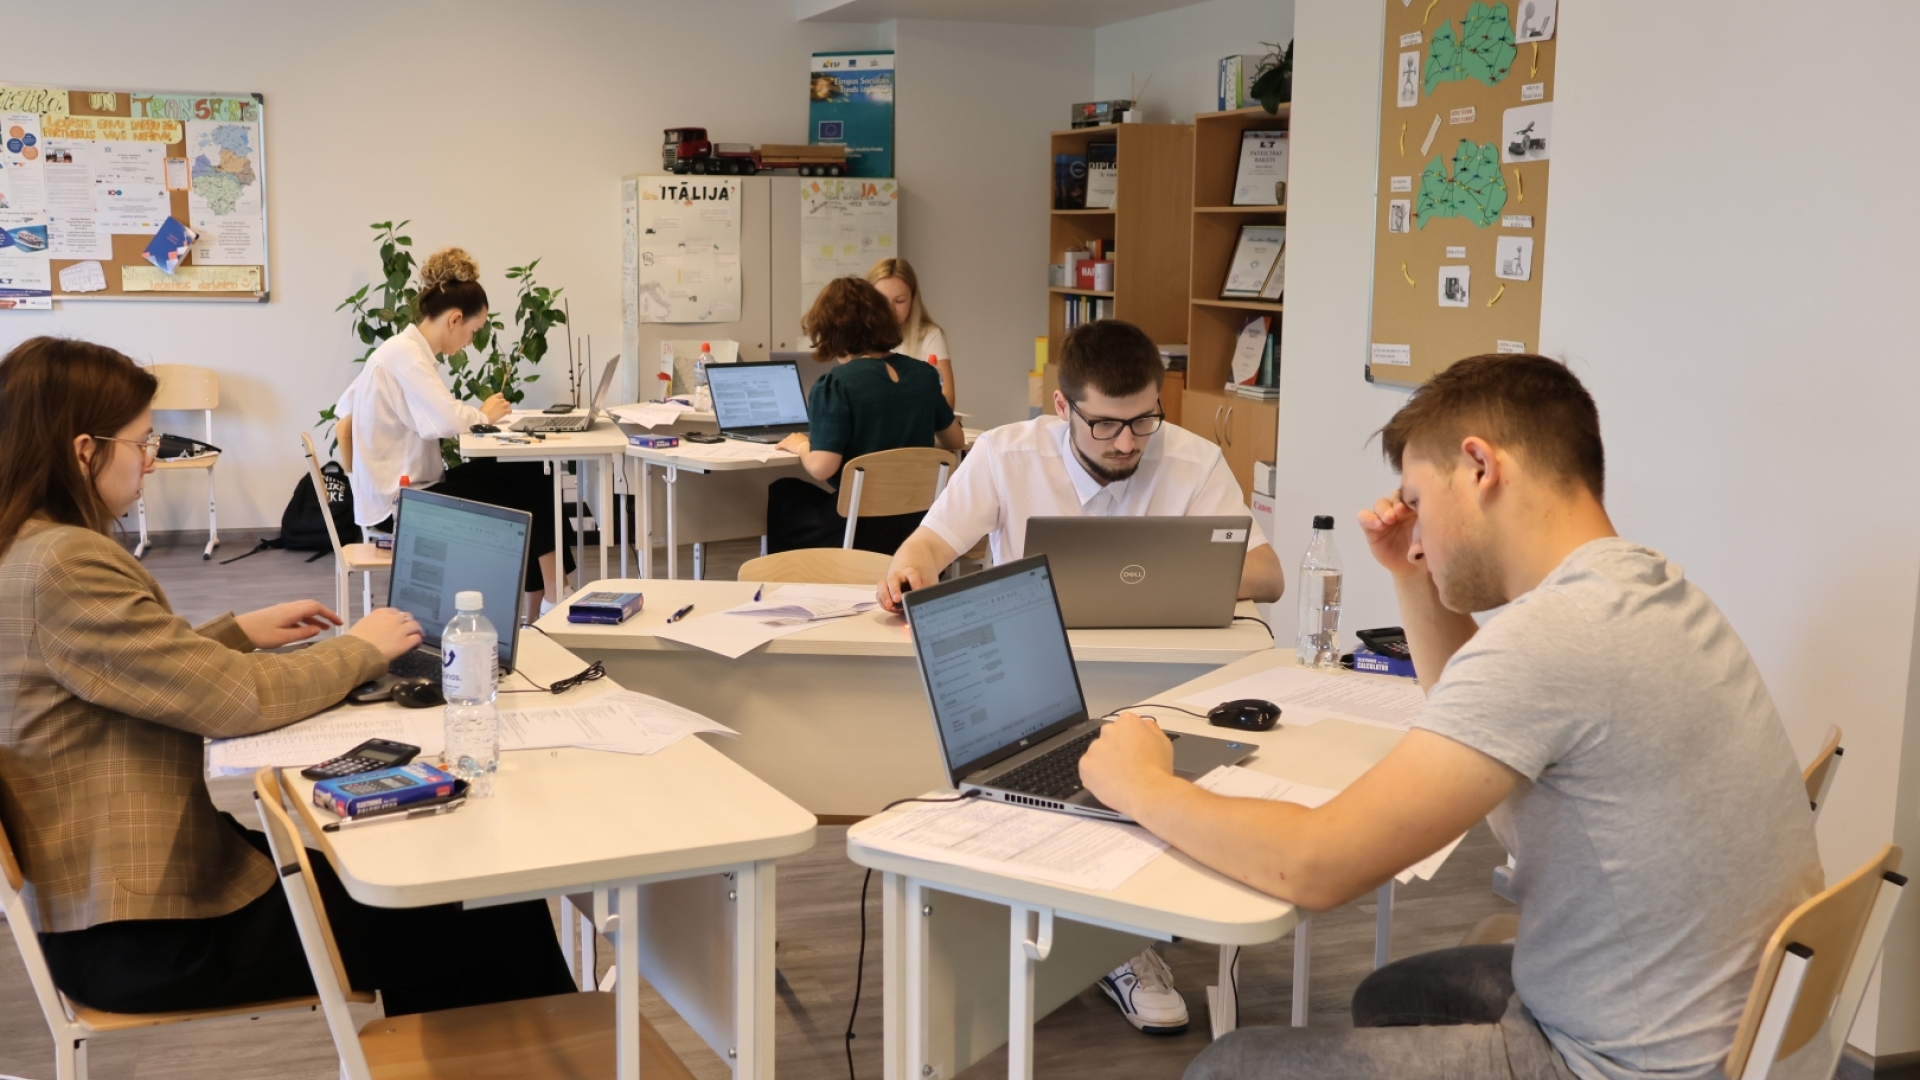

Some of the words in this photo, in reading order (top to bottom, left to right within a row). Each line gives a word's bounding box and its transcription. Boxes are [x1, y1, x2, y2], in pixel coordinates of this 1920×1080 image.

[88, 92, 116, 112] UN
[661, 181, 729, 201] ITĀLIJA
[1253, 500, 1273, 515] Canon
[1226, 531, 1233, 540] 8
[1356, 662, 1389, 672] CALCULATOR
